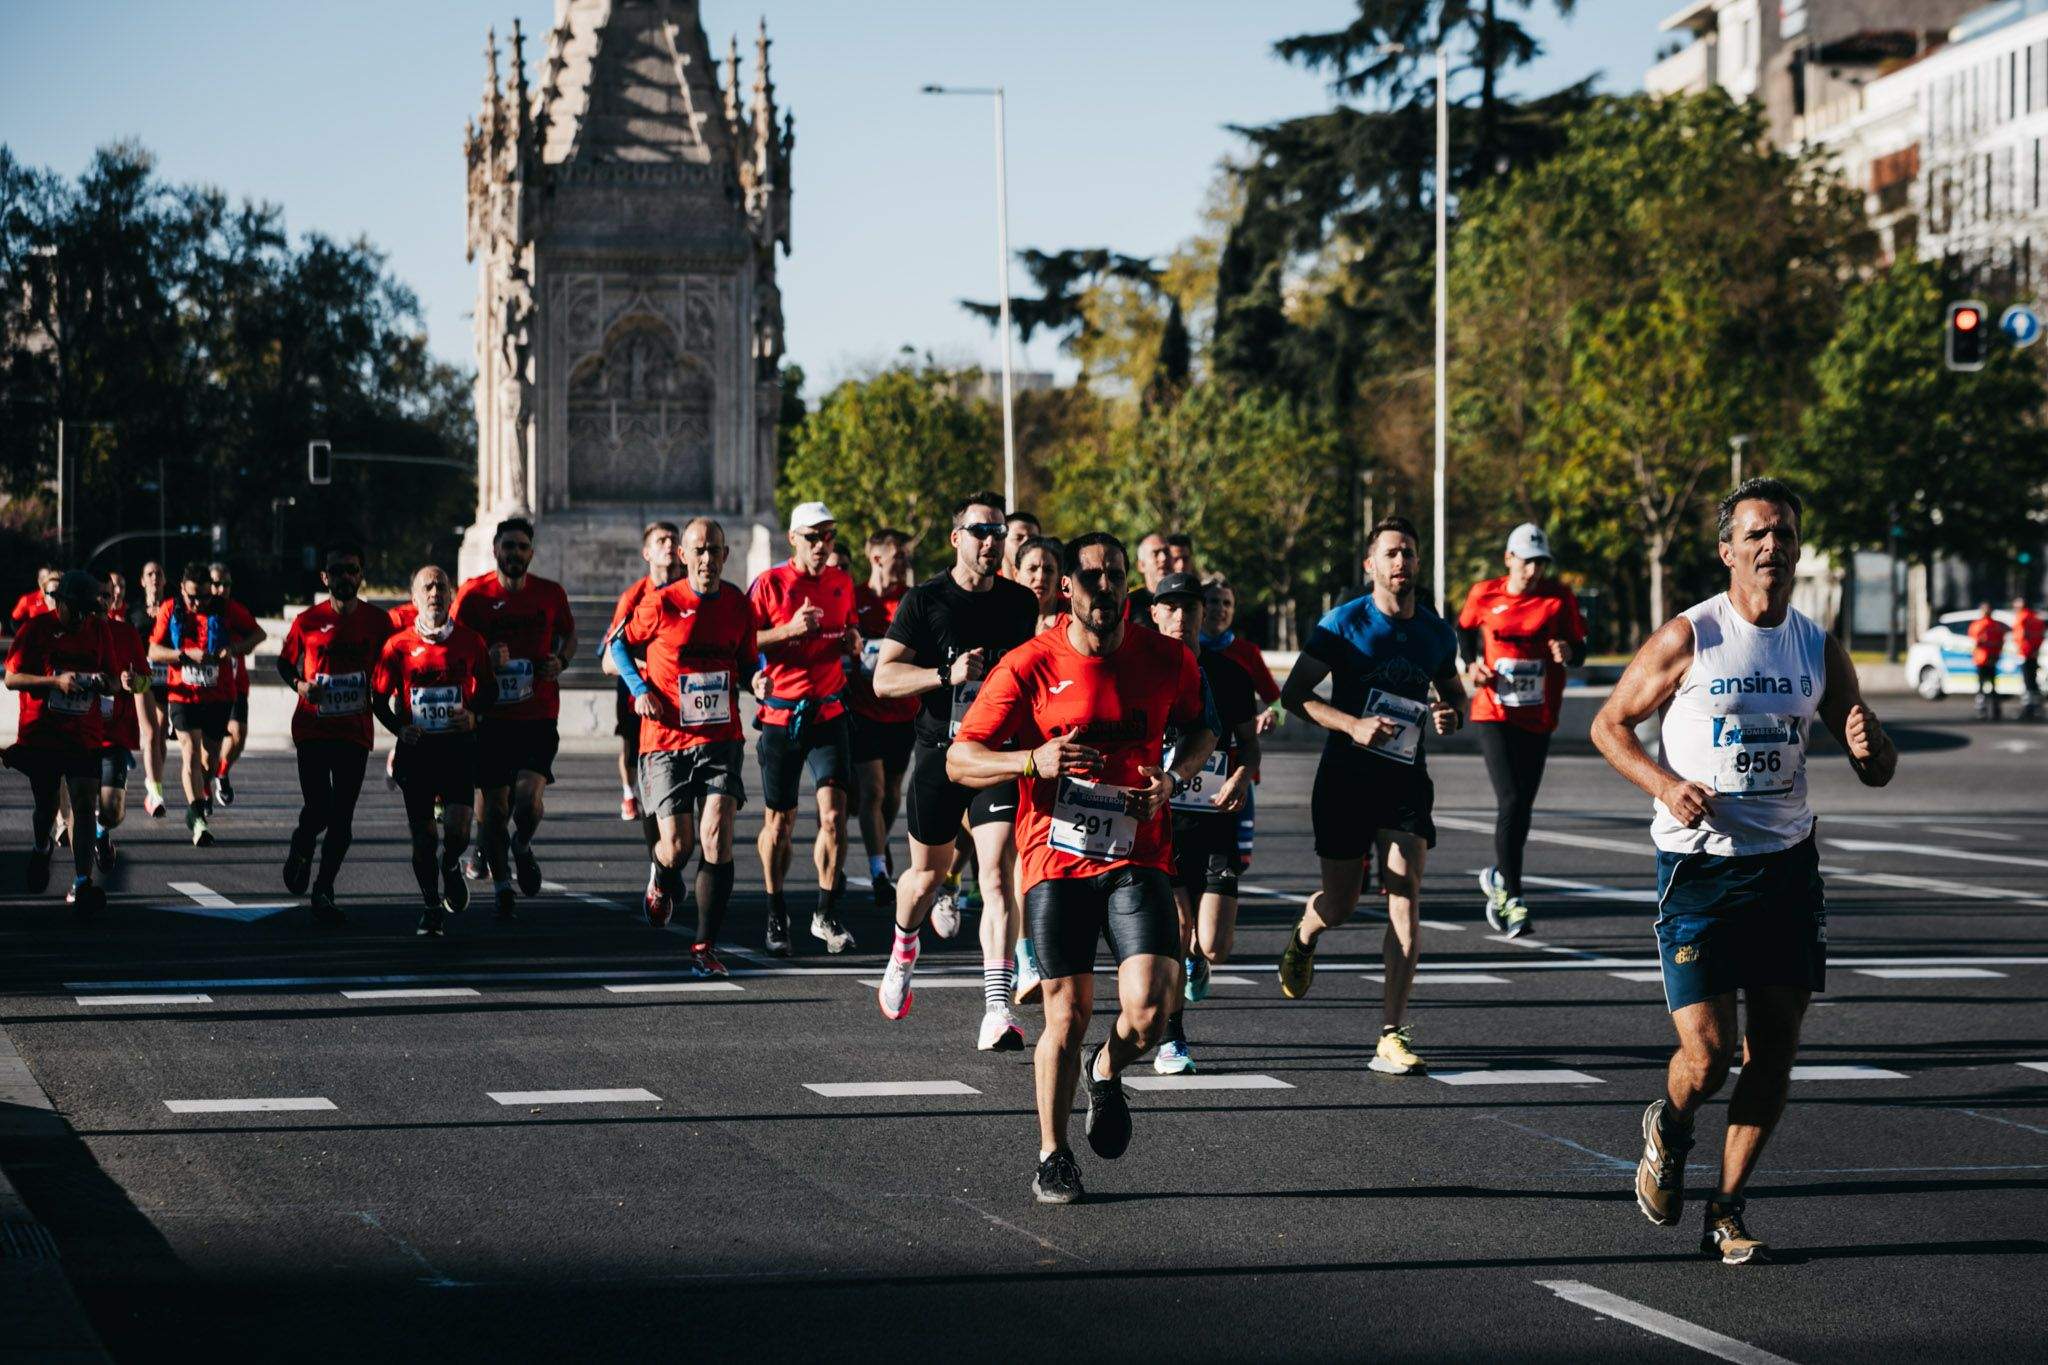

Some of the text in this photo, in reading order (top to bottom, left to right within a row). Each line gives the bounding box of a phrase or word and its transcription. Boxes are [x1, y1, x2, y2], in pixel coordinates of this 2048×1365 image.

[1709, 671, 1793, 695] ansina
[694, 694, 719, 709] 607
[1736, 750, 1781, 773] 956
[1072, 812, 1113, 838] 291
